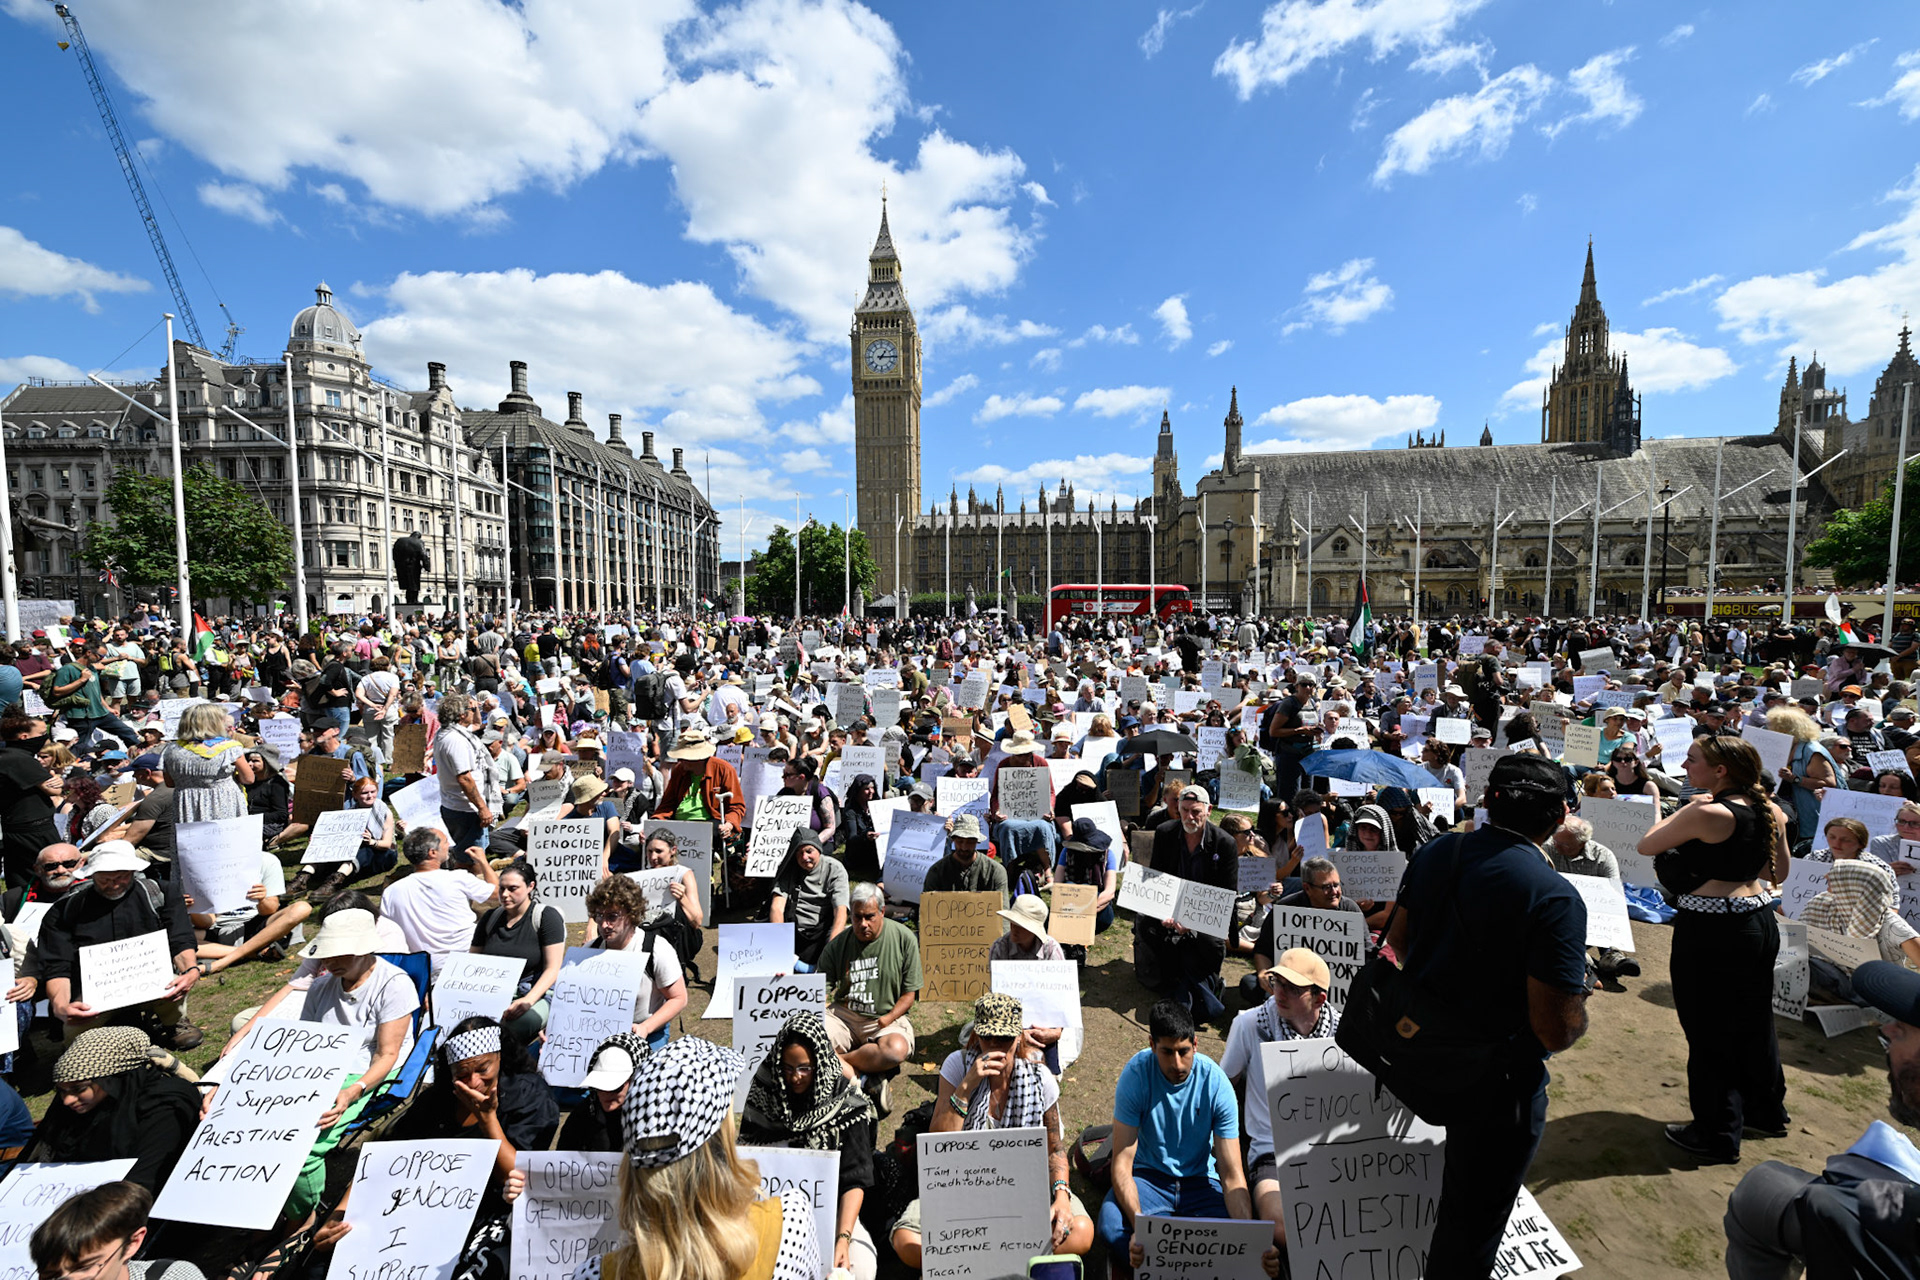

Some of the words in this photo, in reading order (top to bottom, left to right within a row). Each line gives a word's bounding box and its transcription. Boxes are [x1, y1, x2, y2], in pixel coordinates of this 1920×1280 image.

[1012, 768, 1037, 779] OPPOSE
[952, 780, 988, 791] OPPOSE
[938, 791, 984, 803] GENOCIDE
[1010, 791, 1039, 800] SUPPORT
[757, 800, 764, 814] I
[764, 800, 811, 816] OPPOSE
[1004, 800, 1038, 811] PALESTINE
[1013, 809, 1039, 818] ACTION
[332, 811, 366, 821] OPPOSE
[323, 820, 366, 832] GENOCIDE
[534, 825, 537, 836] I
[544, 824, 591, 835] OPPOSE
[322, 834, 360, 845] SUPPORT
[535, 839, 601, 850] GENOCIDE
[752, 834, 758, 848] I
[306, 846, 357, 859] PALESTINE
[752, 848, 786, 857] PALEST
[1341, 855, 1379, 863] OPPOSE
[534, 858, 538, 867] I
[545, 855, 600, 867] SUPPORT
[751, 860, 776, 874] ACTI
[892, 871, 924, 885] ACTIO
[1137, 869, 1175, 888] OPPOSE
[1348, 876, 1399, 885] SUPPORT
[1121, 880, 1172, 906] GENOCIDE
[1184, 883, 1188, 893] I
[1192, 885, 1235, 902] SUPPORT
[927, 900, 931, 922] I
[935, 899, 994, 918] OPPOSE
[1183, 896, 1232, 916] PALESTINE
[1182, 910, 1223, 928] ACTION
[1283, 912, 1287, 927] I
[1292, 913, 1355, 936] OPPOSE
[750, 932, 754, 946] I
[924, 925, 986, 937] GENOCIDE
[729, 949, 763, 962] OPPOSE
[925, 950, 929, 961] I
[463, 964, 511, 979] OPPOSE
[579, 961, 629, 977] OPPOSE
[850, 968, 879, 983] WHILE
[925, 964, 991, 976] PALESTINE
[103, 979, 162, 1001] ACTION
[442, 980, 501, 994] GENOCIDE
[555, 981, 632, 1010] GENOCIDE
[739, 986, 745, 1010] I
[757, 985, 825, 1004] OPPOSE
[563, 1014, 624, 1034] SUPPORT
[250, 1026, 263, 1050] I
[264, 1027, 349, 1057] OPPOSE
[230, 1059, 340, 1084] GENOCIDE
[542, 1053, 588, 1074] ACTI
[1279, 1048, 1307, 1080] I
[236, 1090, 320, 1116] Support
[193, 1123, 300, 1150] PALESTINE
[925, 1142, 928, 1155] I
[934, 1140, 980, 1153] OPPOSE
[989, 1138, 1043, 1151] GENOCIDE
[184, 1156, 281, 1183] ACTION
[357, 1152, 372, 1184] I
[388, 1150, 472, 1180] OPPOSE
[527, 1158, 531, 1190] I
[544, 1161, 619, 1192] OPPOSE
[1289, 1161, 1309, 1190] I
[1329, 1152, 1431, 1184] SUPPORT
[524, 1197, 614, 1229] GENOCID
[1293, 1193, 1443, 1249] PALESTIN
[928, 1231, 931, 1245] I
[939, 1226, 989, 1242] SUPPORT
[1147, 1221, 1152, 1234] I
[1161, 1223, 1218, 1240] Oppose
[379, 1226, 407, 1253] I
[1157, 1239, 1247, 1256] GENOCIDE
[527, 1238, 531, 1266] I
[925, 1242, 991, 1256] PALESTINE
[1000, 1241, 1043, 1251] ACTION
[1146, 1255, 1150, 1267] I
[1156, 1256, 1213, 1273] Support
